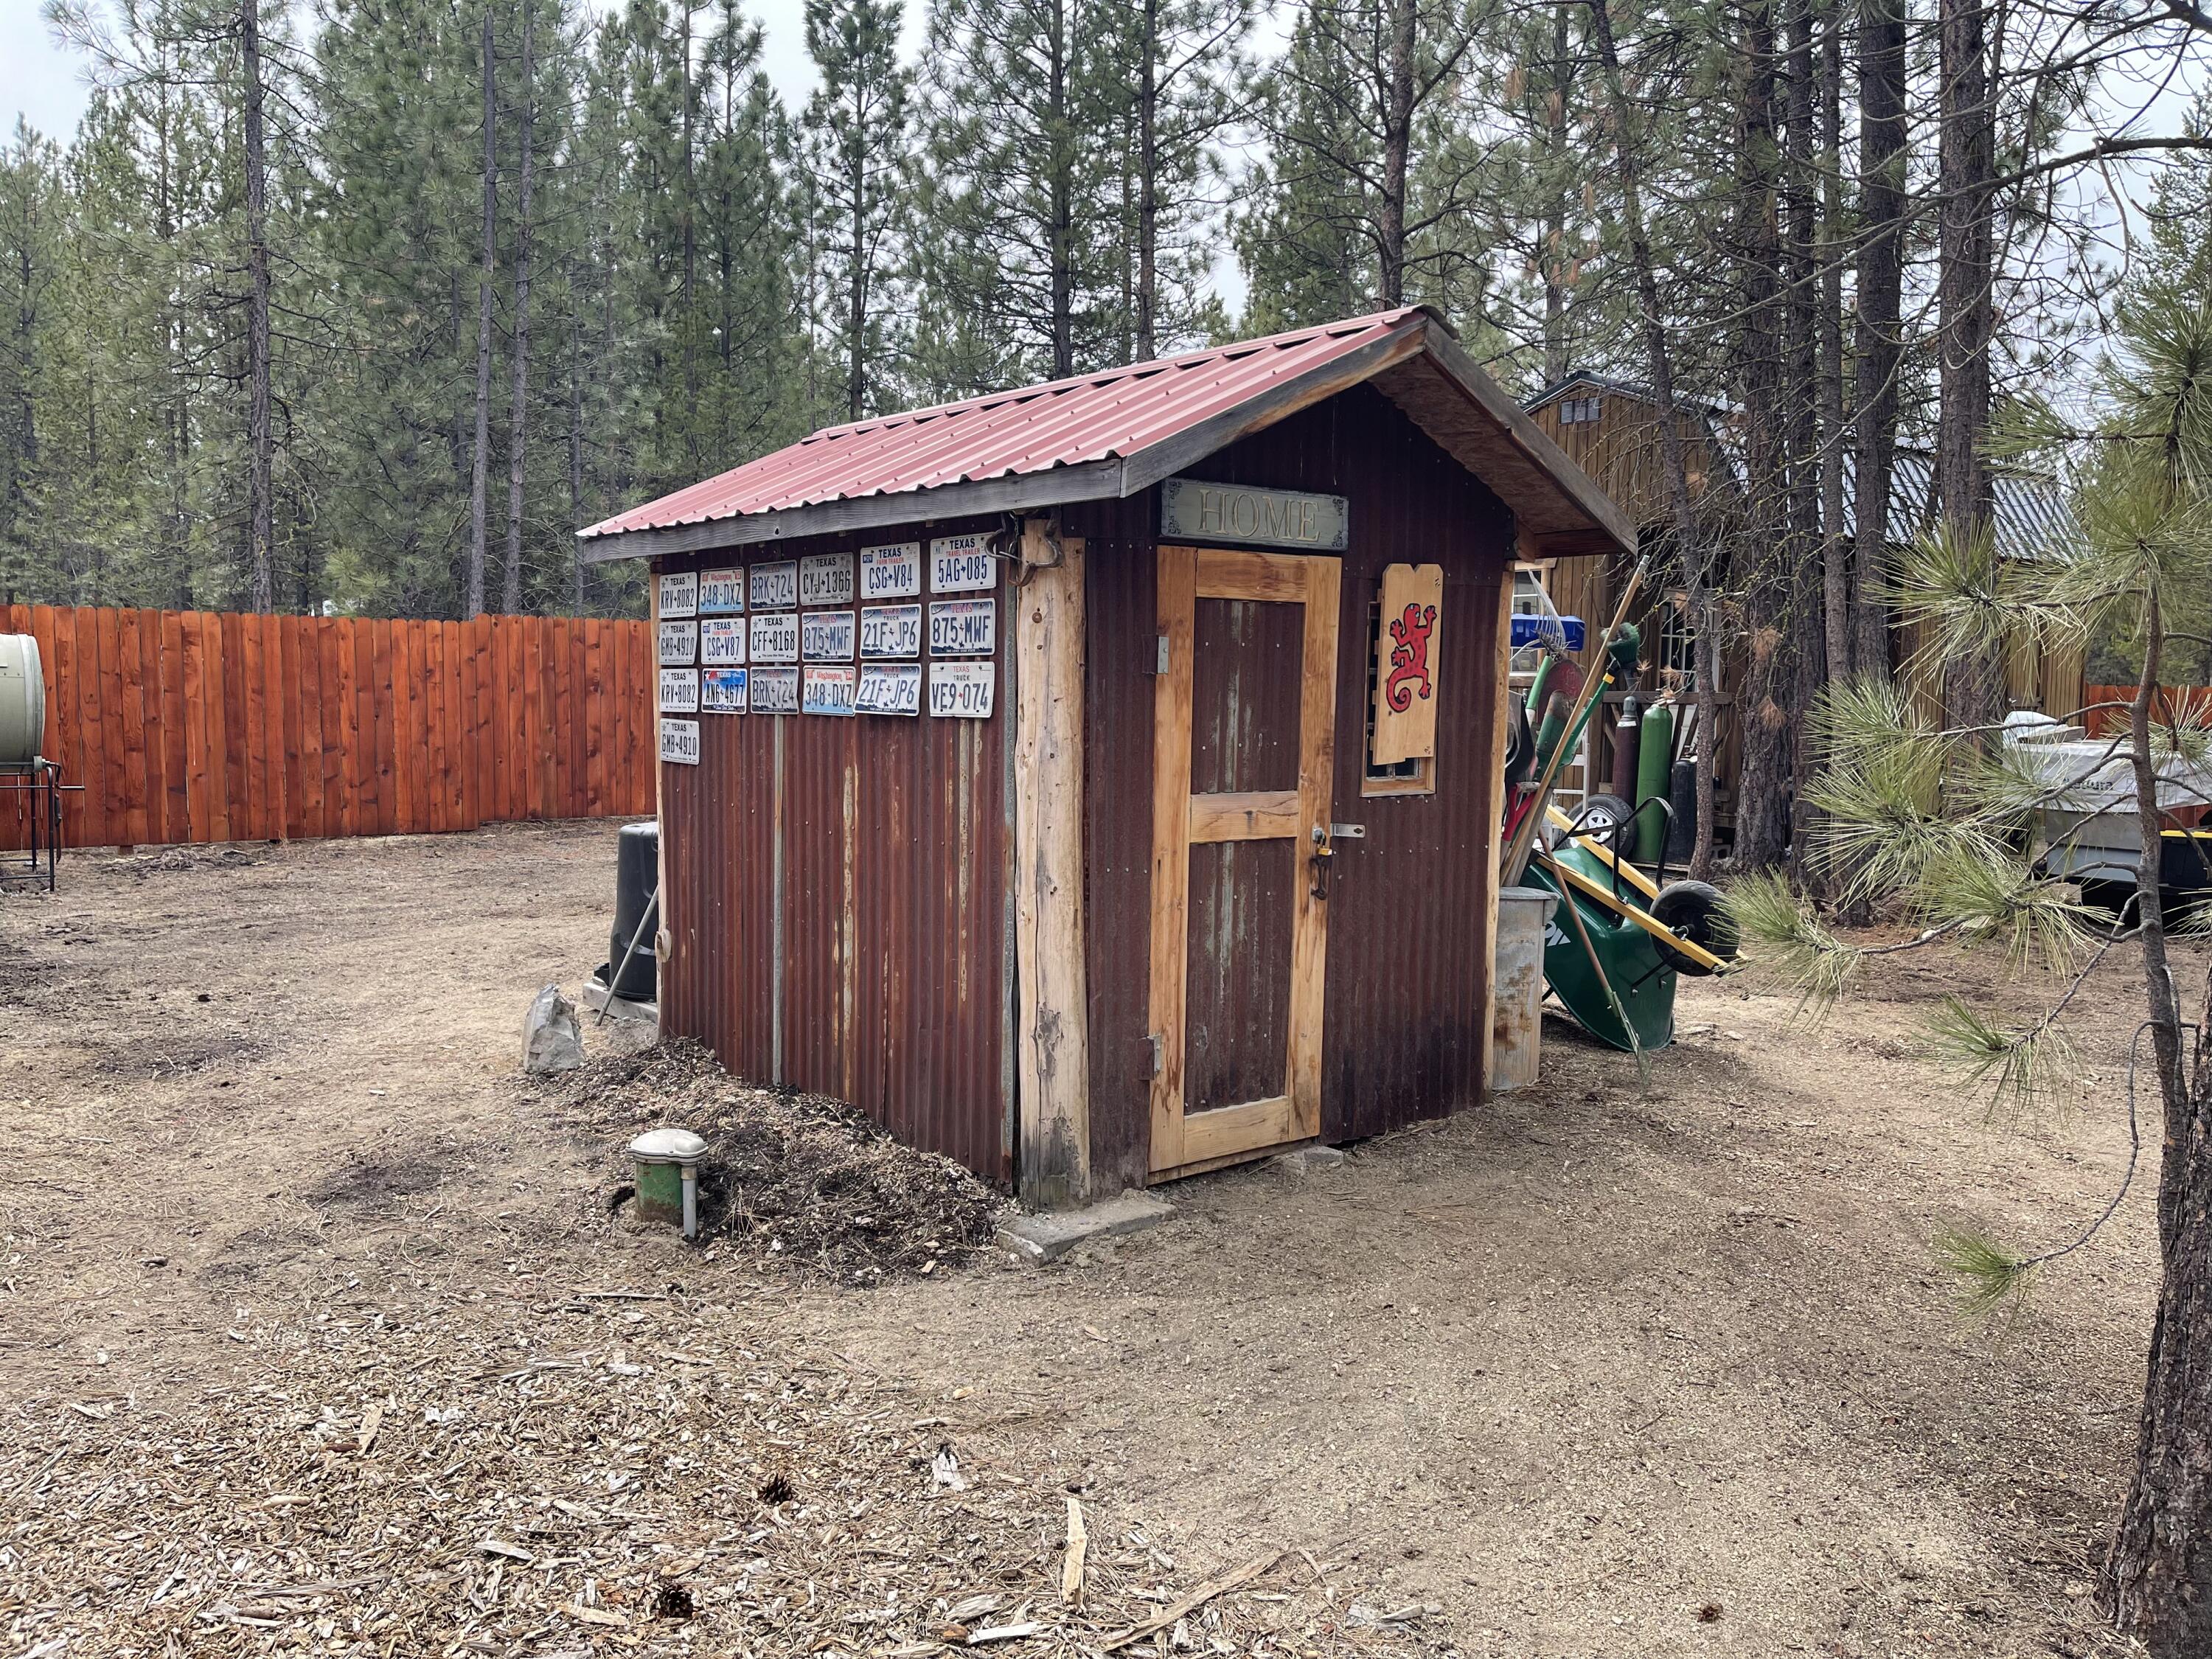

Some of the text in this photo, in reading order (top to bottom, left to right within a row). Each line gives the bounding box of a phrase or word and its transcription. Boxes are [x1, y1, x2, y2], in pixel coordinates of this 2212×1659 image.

[1197, 488, 1321, 543] HOME
[878, 547, 902, 558] TEXAS
[950, 538, 975, 550] TEXAS
[962, 548, 980, 556] TRAILER
[815, 557, 836, 568] TEXAS
[939, 555, 987, 583] 5AG 085
[670, 577, 686, 586] TEXAS
[869, 563, 913, 589] CSG V84
[701, 582, 742, 606] 348 DXZ
[752, 574, 793, 599] BRK 724
[950, 604, 973, 613] TEXAS
[670, 625, 685, 633] TEXAS
[713, 622, 731, 630] TEXAS
[764, 617, 783, 626] TEXAS
[933, 615, 990, 643] 875 MWF
[752, 630, 795, 651] CFF 8168
[804, 626, 851, 650] 875 MWF
[863, 620, 917, 647] 21F JP6
[707, 636, 740, 656] CSG V87
[671, 672, 686, 681] TEXAS
[816, 671, 842, 682] Washington
[806, 683, 852, 708] 348 DXZ
[859, 679, 917, 704] 21F JP6
[932, 683, 987, 710] VE9 074
[671, 723, 686, 732] TEXAS
